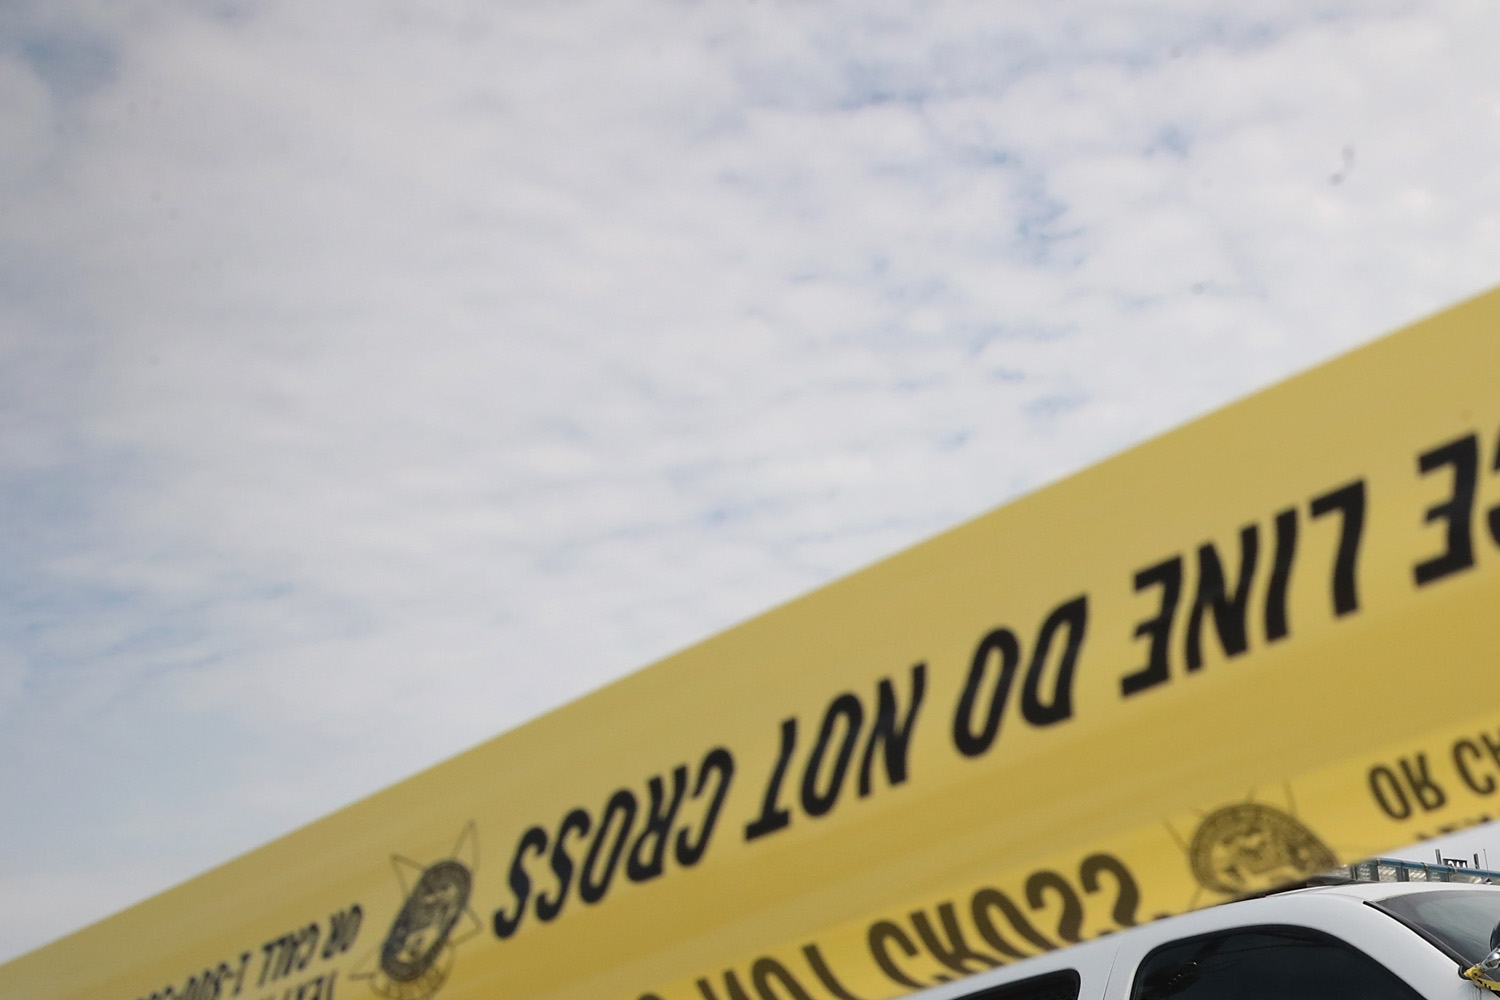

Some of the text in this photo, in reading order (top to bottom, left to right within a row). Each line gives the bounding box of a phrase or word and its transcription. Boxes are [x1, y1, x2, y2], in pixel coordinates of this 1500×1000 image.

[951, 592, 1090, 761] DO
[1119, 477, 1368, 699] LINE
[493, 747, 735, 940] CROSS
[744, 664, 927, 842] NOT
